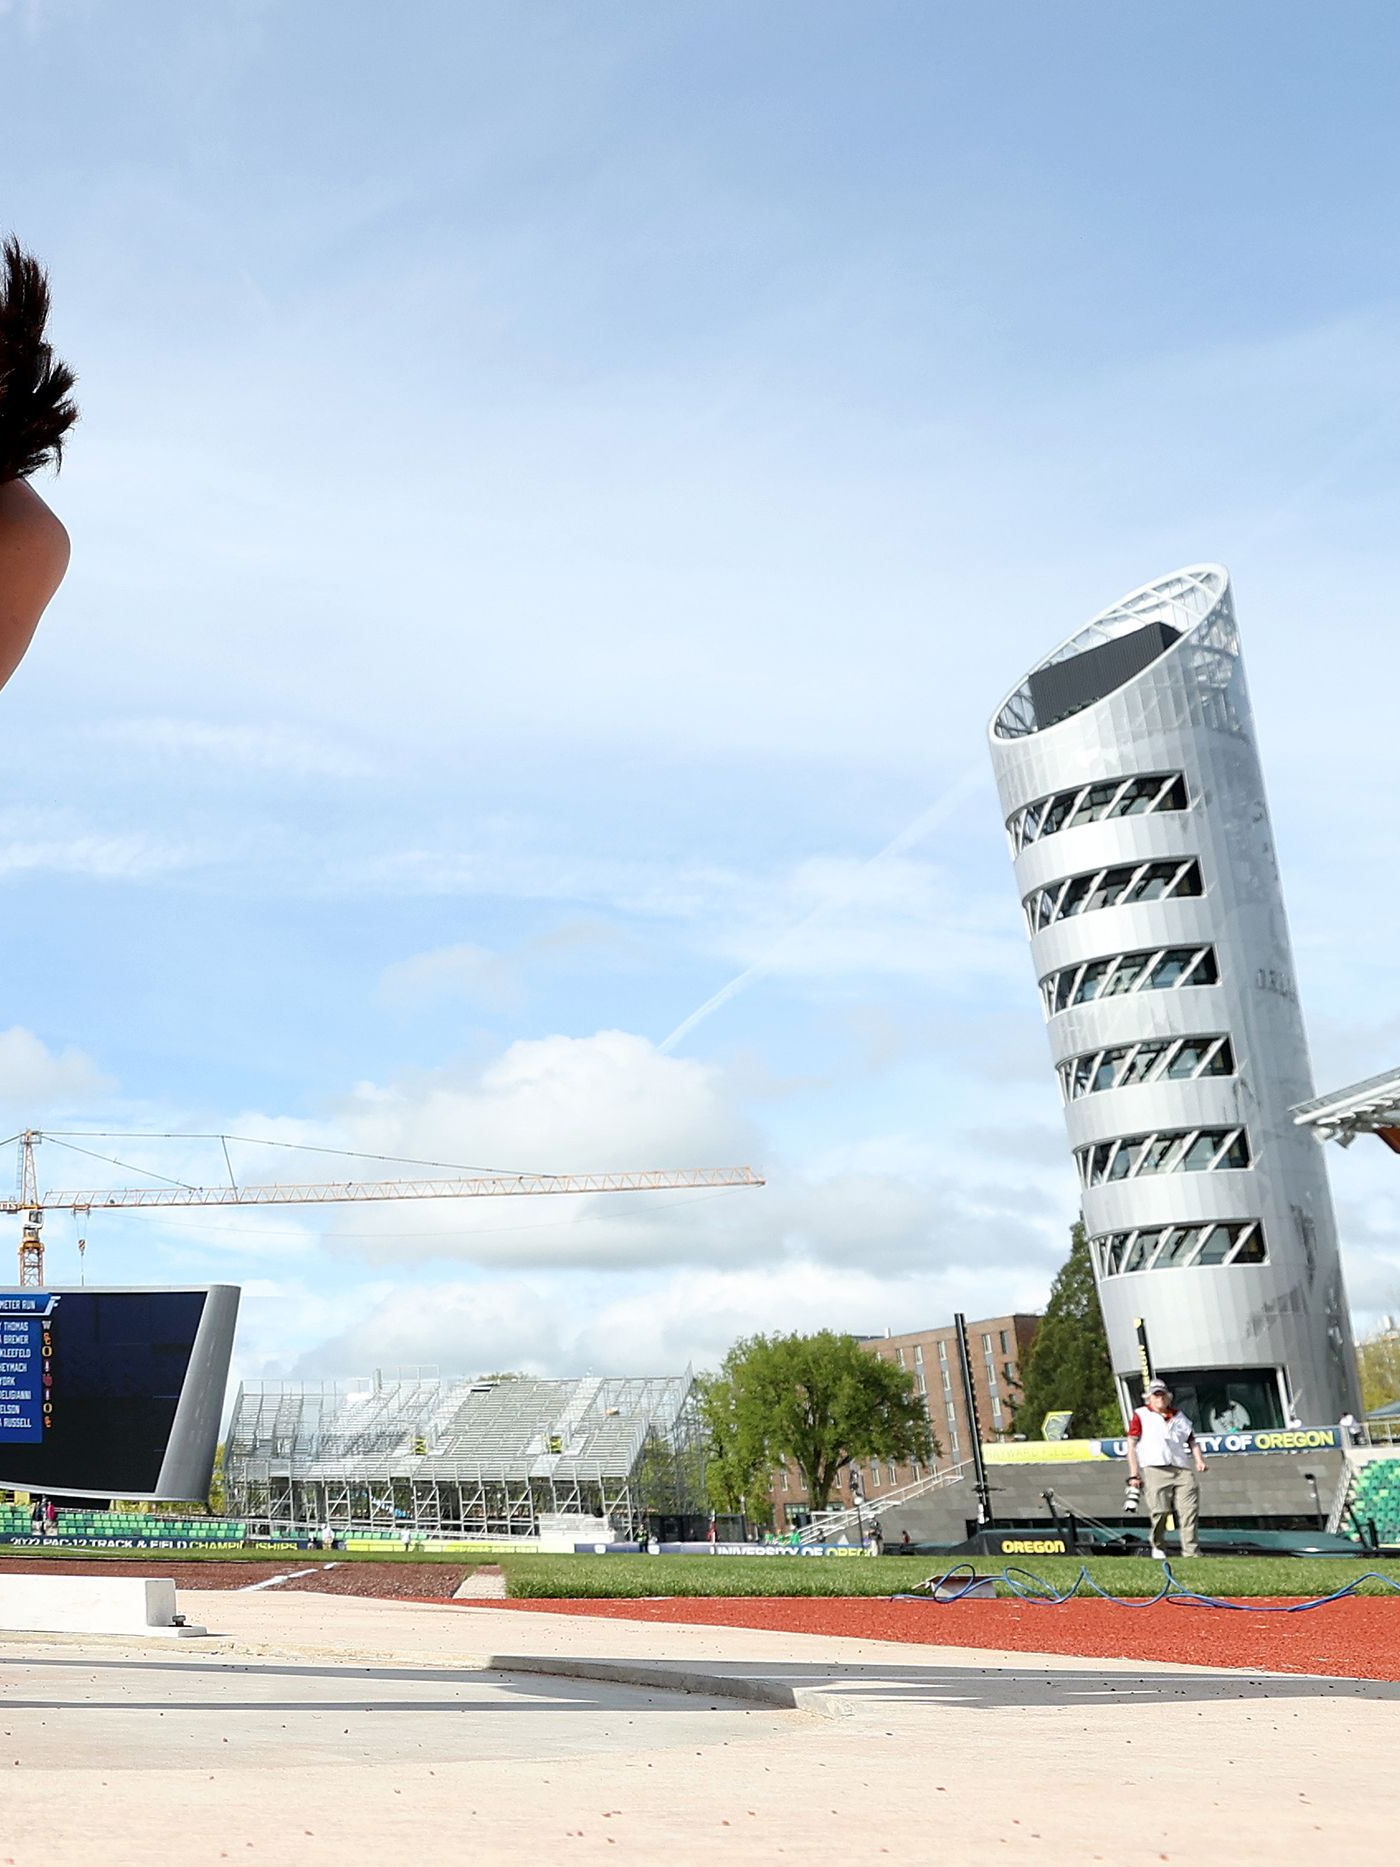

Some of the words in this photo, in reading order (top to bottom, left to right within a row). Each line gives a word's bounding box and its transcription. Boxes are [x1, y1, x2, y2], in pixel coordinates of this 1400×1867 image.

[0, 1299, 21, 1310] METER
[22, 1299, 36, 1310] RUN
[3, 1321, 29, 1331] THOMAS
[3, 1417, 32, 1429] RUSSELL
[1224, 1435, 1253, 1451] OF
[1254, 1430, 1334, 1450] OREGON
[10, 1537, 40, 1547] 2022
[42, 1537, 88, 1548] PAC-12
[89, 1538, 133, 1549] TRACK
[136, 1538, 148, 1549] &
[150, 1539, 188, 1549] FIELD
[1002, 1540, 1066, 1554] OREGON
